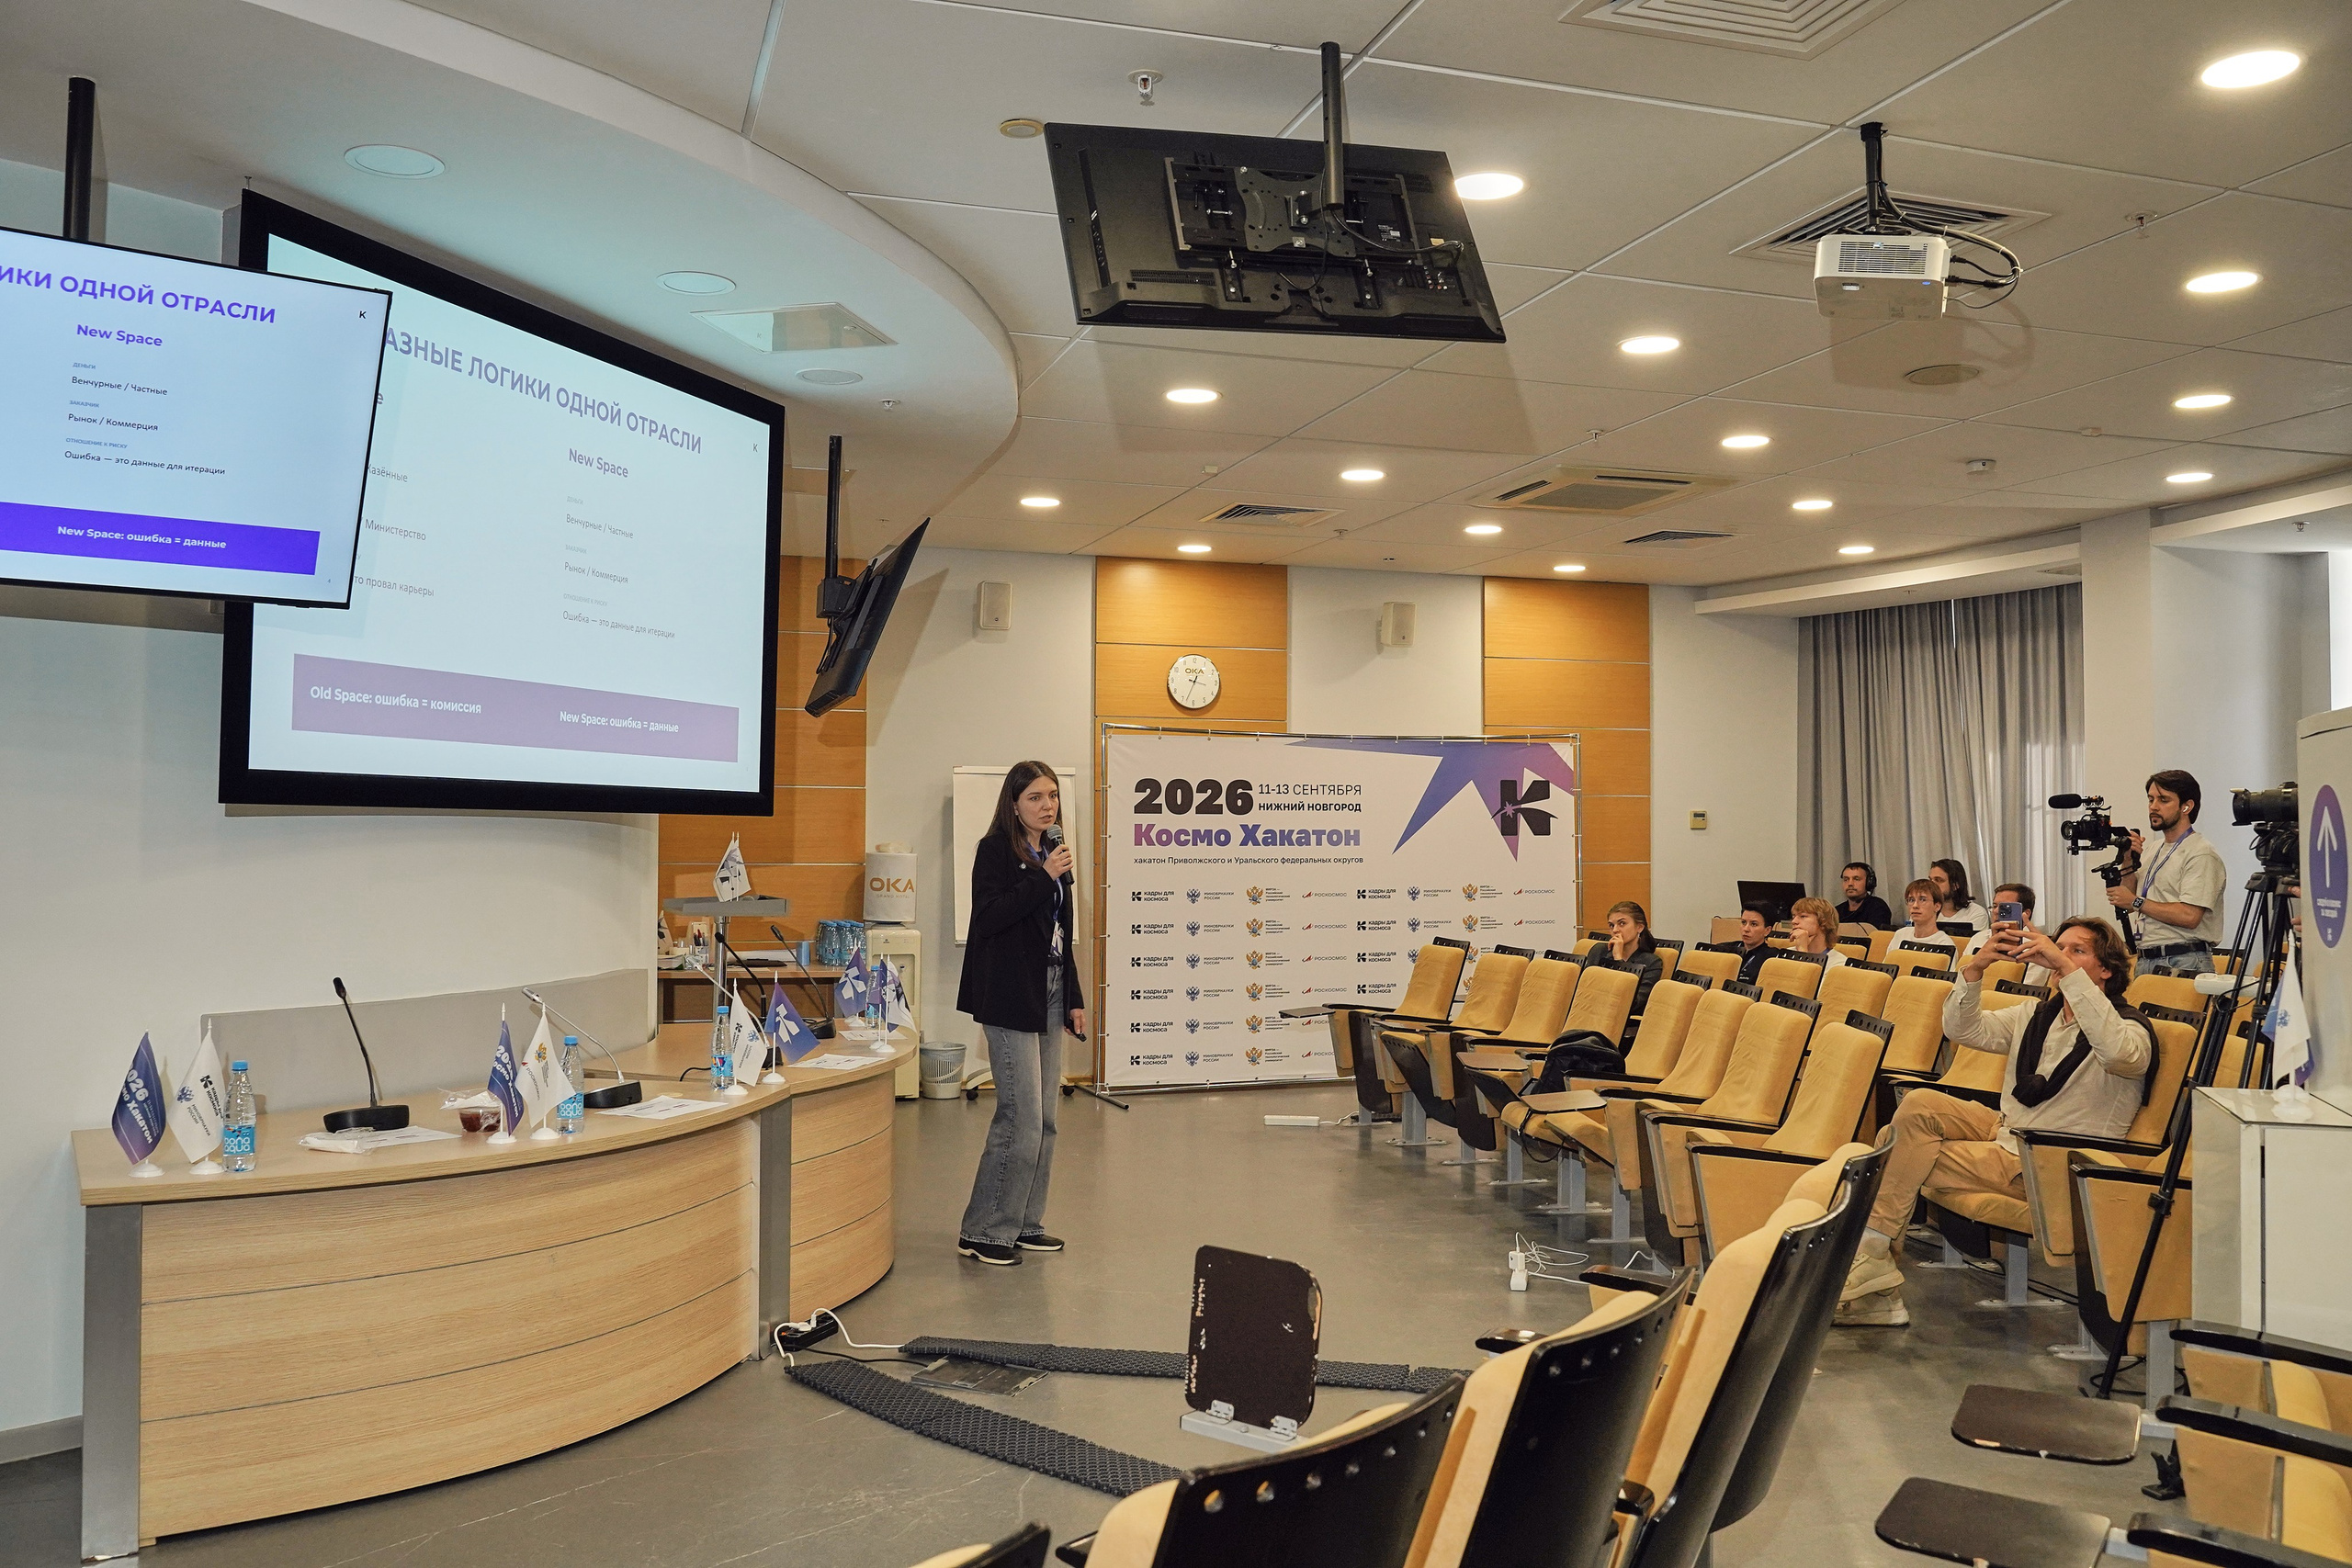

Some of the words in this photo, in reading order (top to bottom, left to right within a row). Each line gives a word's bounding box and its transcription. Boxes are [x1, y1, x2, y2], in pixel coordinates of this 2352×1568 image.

[0, 265, 51, 288] ИКИ
[60, 276, 153, 304] ОДНОЙ
[161, 291, 275, 323] ОТРАСЛИ
[76, 324, 112, 339] New
[116, 330, 163, 346] Space
[72, 376, 121, 389] Венчурные
[130, 383, 167, 395] Частные
[384, 321, 462, 372] АЗНЫЕ
[468, 355, 549, 402] ЛОГИКИ
[556, 387, 621, 426] ОДНОЙ
[626, 412, 701, 454] ОТРАСЛИ
[68, 412, 96, 423] Рынок
[106, 418, 158, 431] Коммерция
[64, 450, 100, 461] Ошибка
[130, 459, 164, 468] данные
[185, 466, 225, 475] итерации
[569, 447, 594, 467] New
[596, 457, 628, 478] Space
[57, 525, 85, 536] New
[86, 528, 124, 539] Space:
[126, 534, 172, 544] ошибка
[183, 538, 226, 548] данные
[365, 518, 425, 540] Министерство
[566, 513, 602, 531] Венчурные
[607, 524, 633, 538] Частные
[564, 561, 585, 574] Рынок
[591, 568, 628, 583] Коммерция
[354, 575, 364, 584] то
[366, 578, 396, 590] провал
[399, 583, 434, 596] карьеры
[562, 610, 589, 623] Ошибка
[598, 618, 609, 626] это
[610, 621, 634, 631] данные
[635, 625, 647, 634] для
[648, 626, 675, 639] итерации
[310, 686, 331, 699] Old
[334, 688, 372, 704] Space:
[375, 694, 419, 707] ошибка
[430, 700, 481, 713] комиссия
[560, 711, 579, 722] New
[581, 713, 608, 726] Space:
[609, 716, 641, 728] ошибка
[649, 722, 679, 732] данные
[1134, 778, 1254, 815] 2026
[1258, 784, 1289, 794] 11-13
[1293, 784, 1361, 795] СЕНТЯБРЯ
[1259, 800, 1305, 810] НИЖНИЙ
[1307, 803, 1361, 812] НОВГОРОД
[1134, 823, 1231, 846] Космо
[1238, 824, 1360, 846] Хакатон
[1168, 856, 1226, 865] Приволжского
[1234, 856, 1279, 864] Уральского
[1280, 856, 1331, 864] федеральных
[869, 877, 915, 893] OKA
[492, 1058, 509, 1079] осмо
[127, 1068, 149, 1101] 026
[127, 1100, 153, 1144] Хакатон
